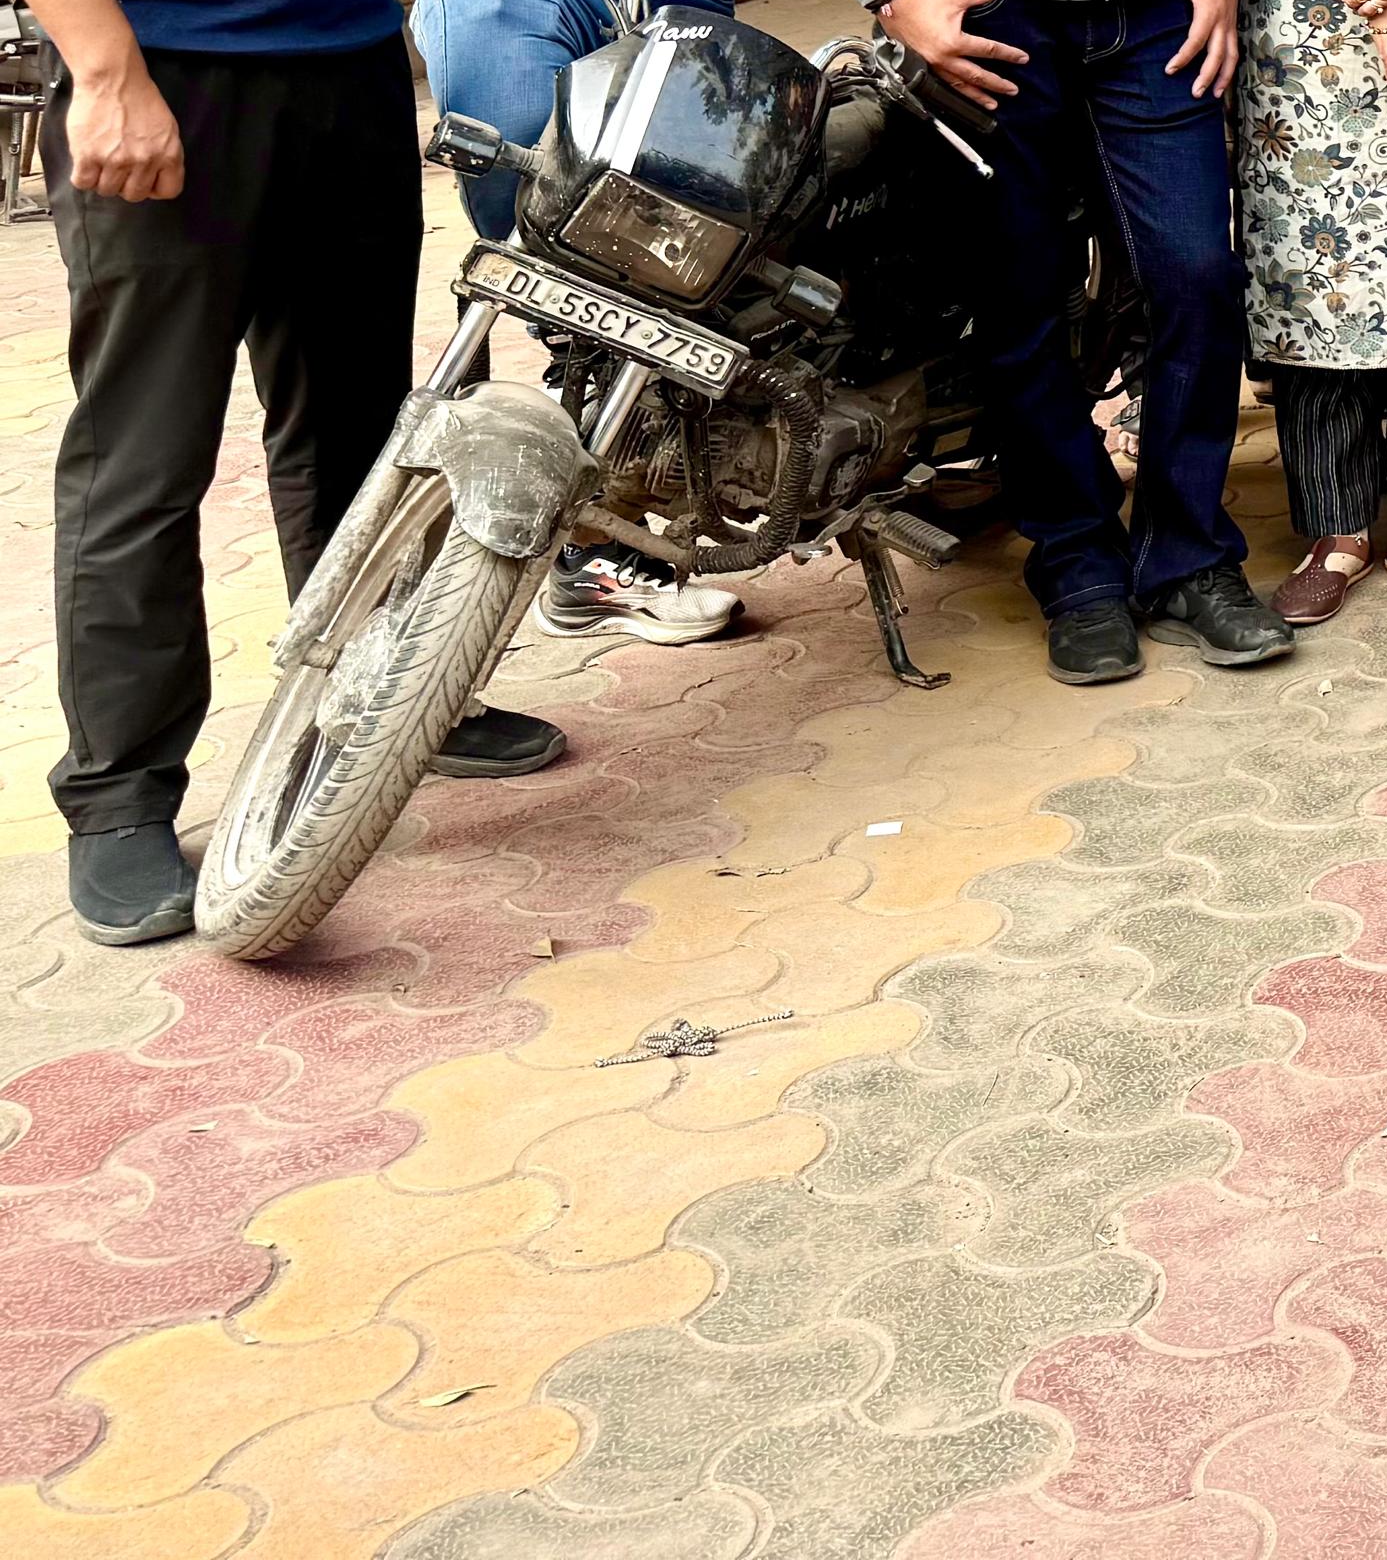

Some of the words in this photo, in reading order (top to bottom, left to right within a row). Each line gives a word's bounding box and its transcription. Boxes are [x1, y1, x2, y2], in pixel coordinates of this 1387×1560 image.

[482, 274, 500, 287] IND
[507, 270, 544, 306] DL
[559, 292, 640, 339] 5SCY
[647, 327, 726, 376] 7759
